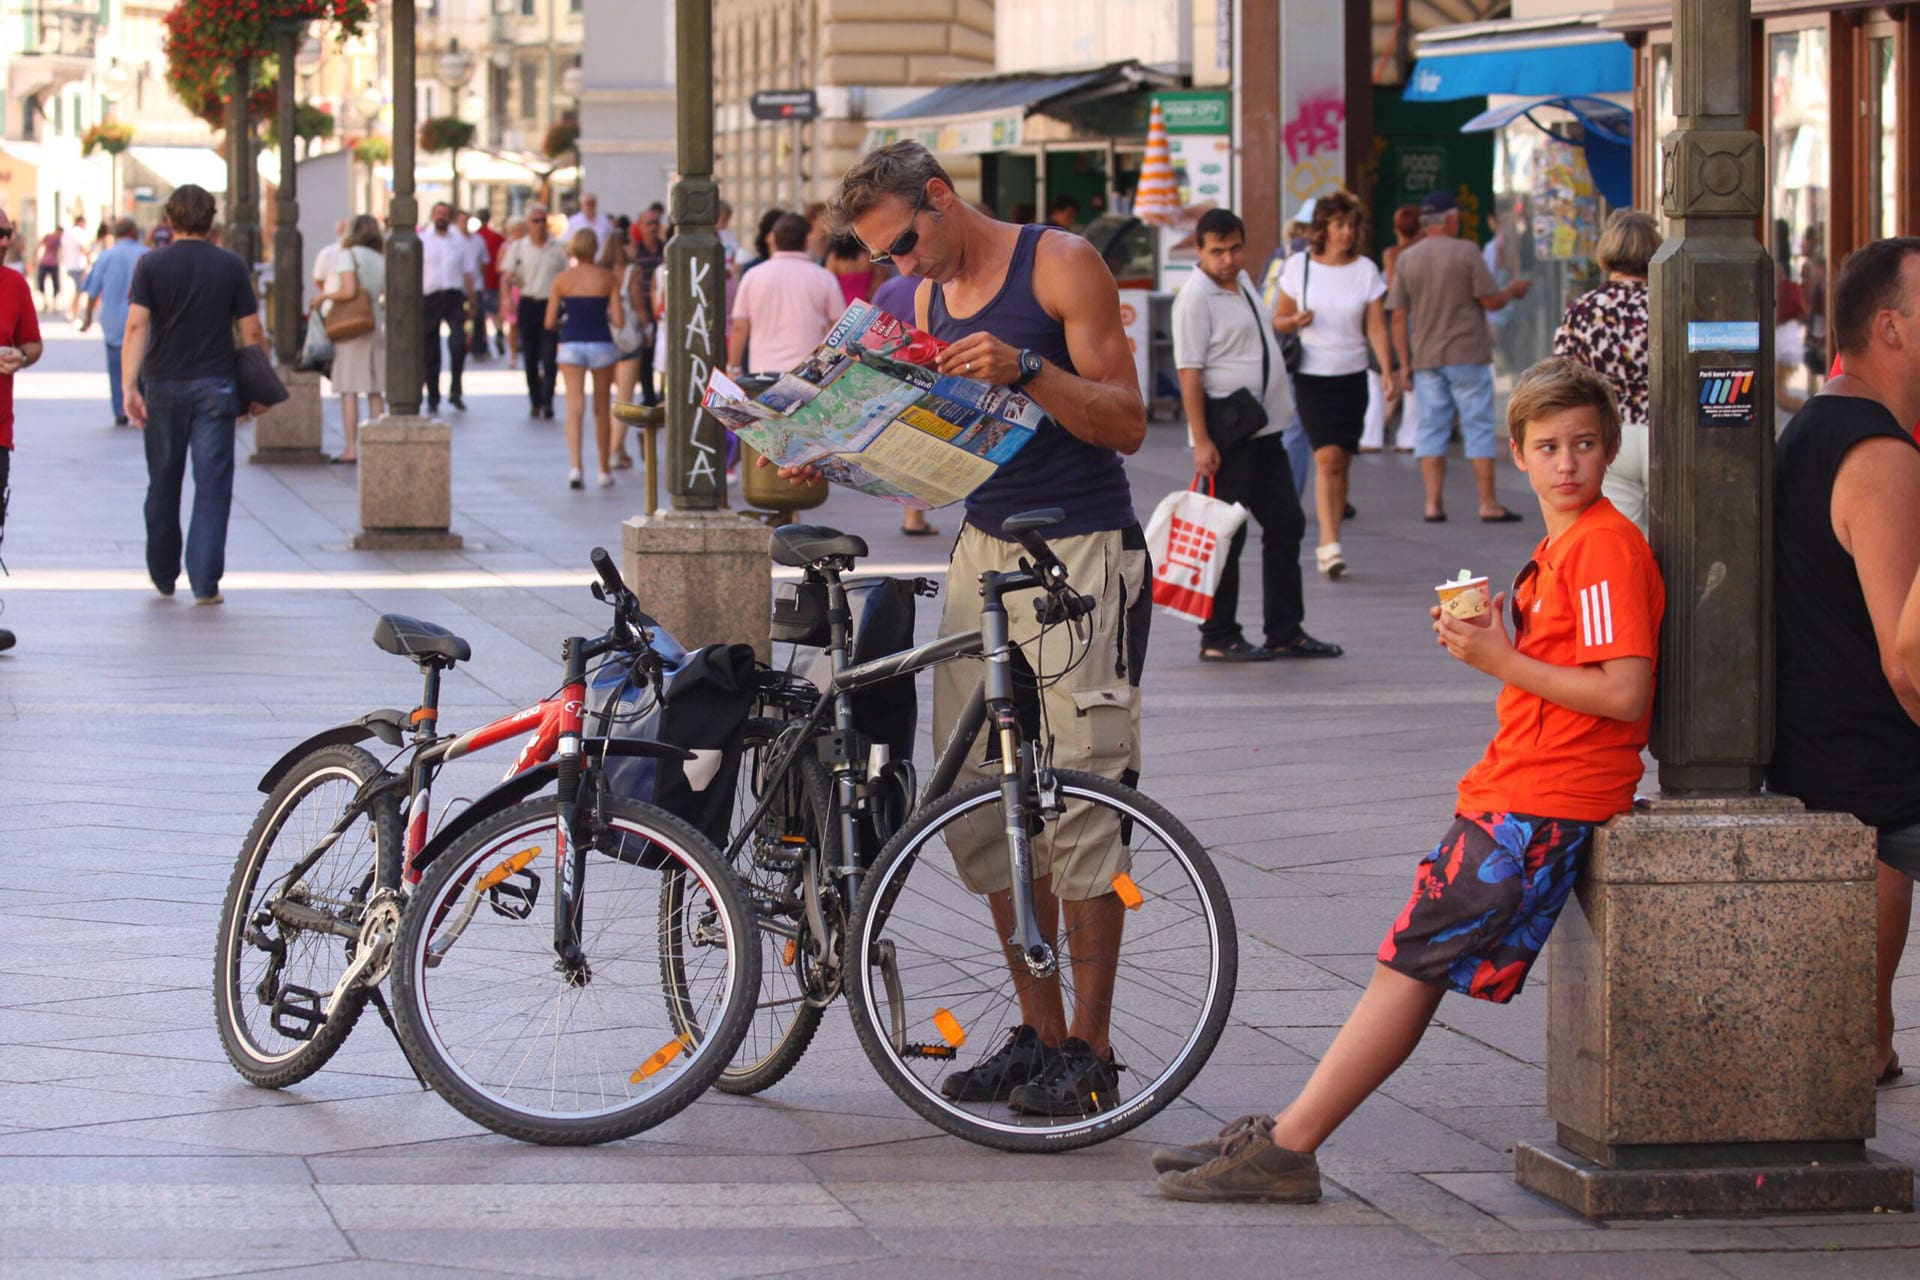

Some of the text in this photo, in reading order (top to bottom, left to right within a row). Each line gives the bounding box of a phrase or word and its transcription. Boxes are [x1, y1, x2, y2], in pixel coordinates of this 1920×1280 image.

[1402, 154, 1440, 171] FOOD
[827, 305, 862, 346] OPATIJA
[685, 256, 716, 488] KARLA
